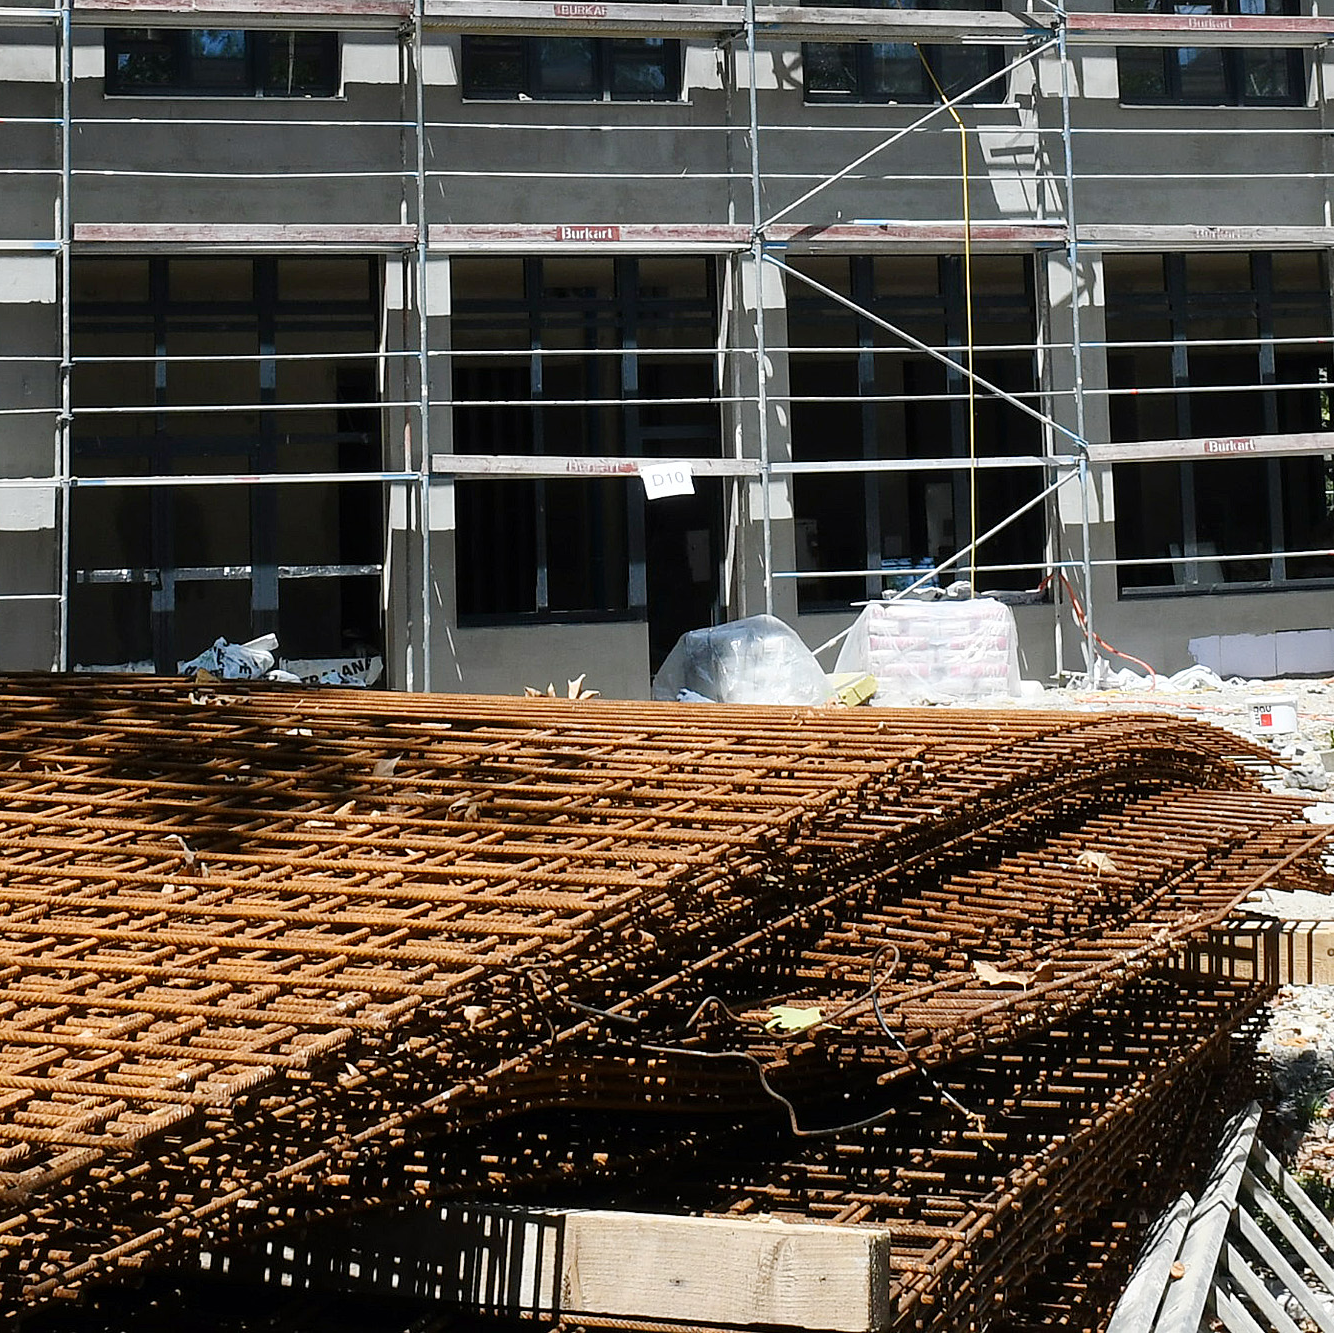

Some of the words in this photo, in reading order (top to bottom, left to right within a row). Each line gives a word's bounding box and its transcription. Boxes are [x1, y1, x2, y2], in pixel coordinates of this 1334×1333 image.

[561, 226, 614, 241] Burkart
[1208, 438, 1255, 453] Burkart
[651, 470, 685, 488] D10
